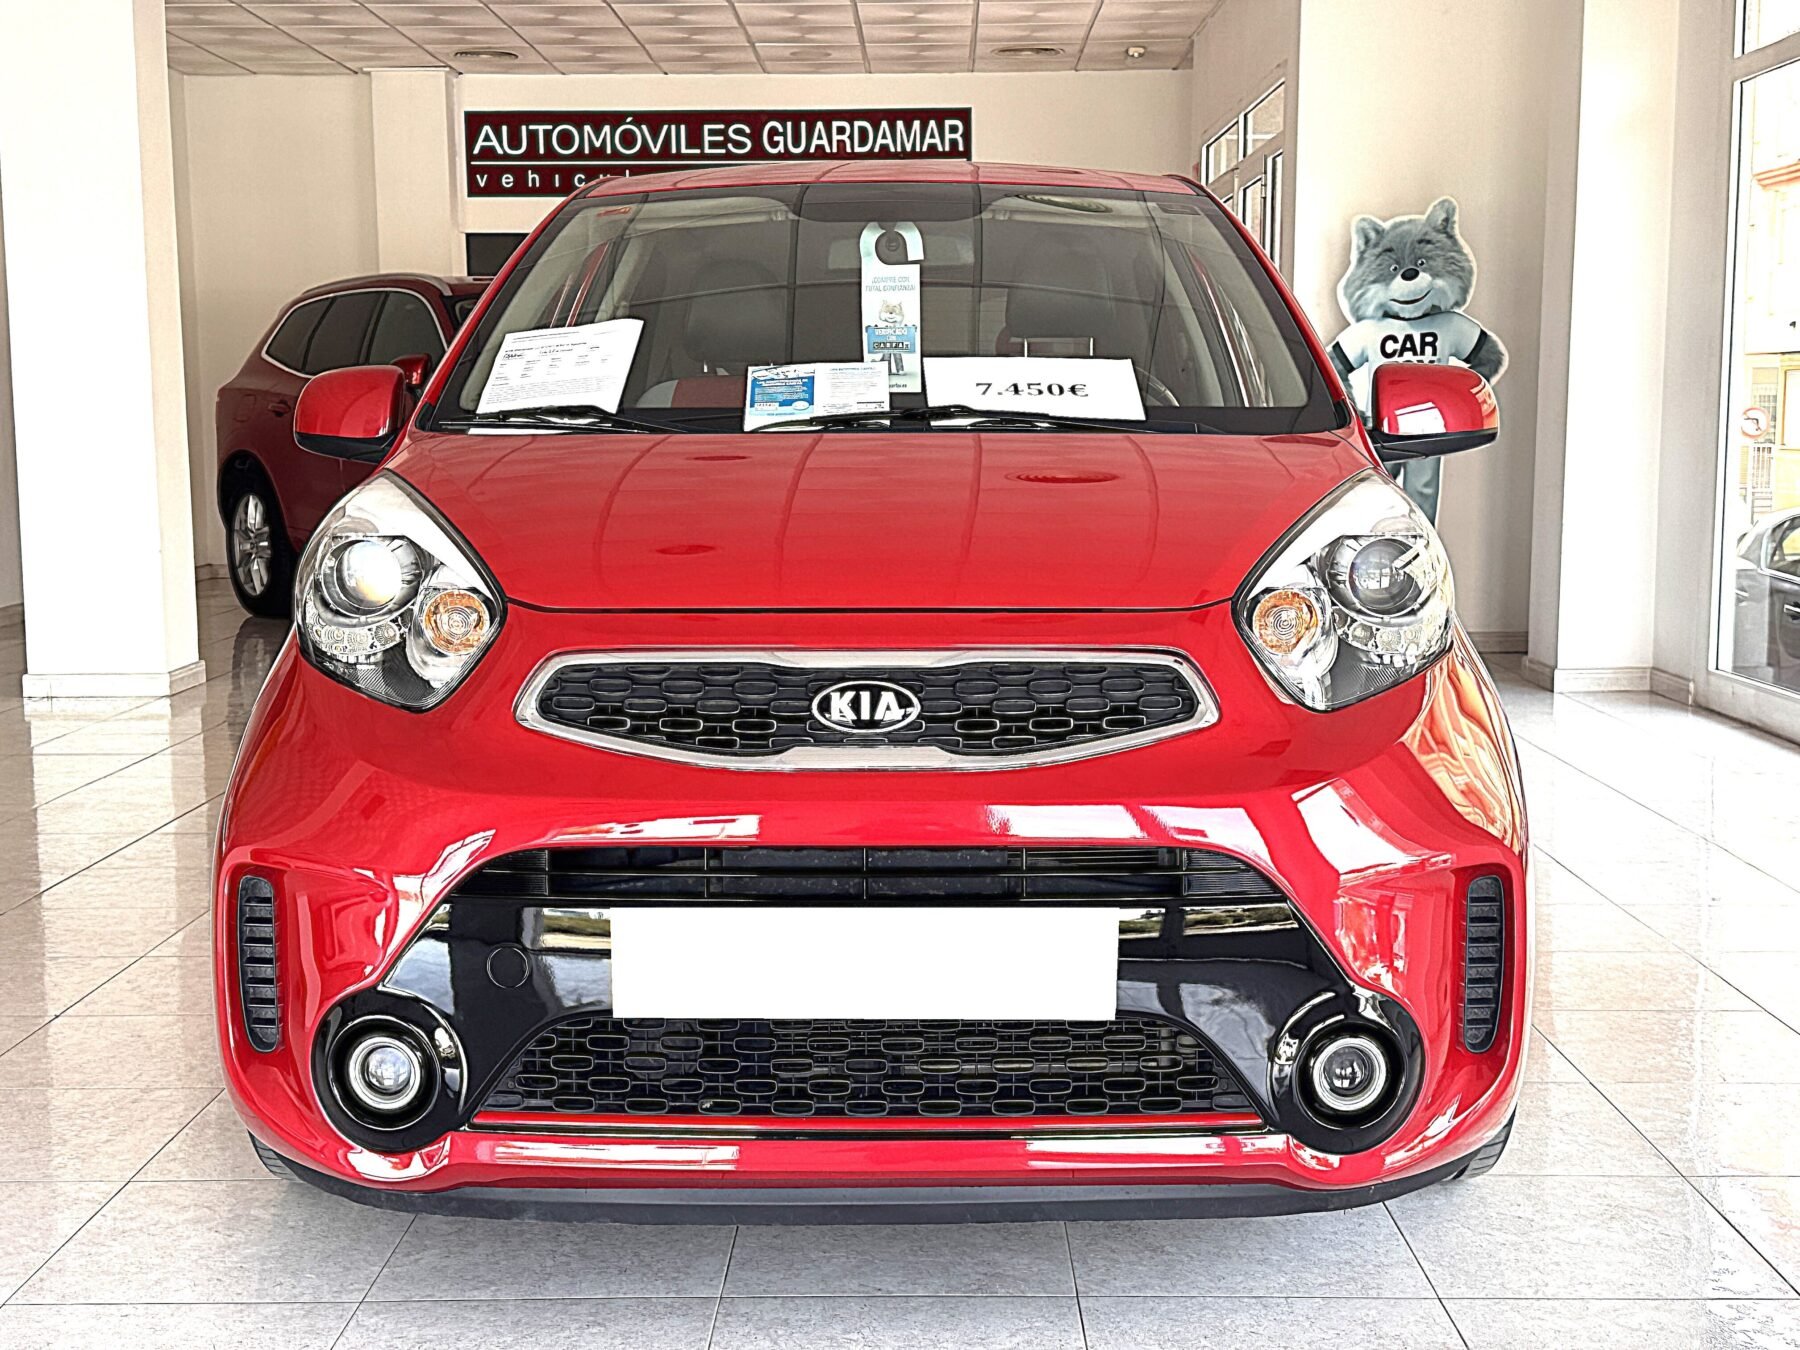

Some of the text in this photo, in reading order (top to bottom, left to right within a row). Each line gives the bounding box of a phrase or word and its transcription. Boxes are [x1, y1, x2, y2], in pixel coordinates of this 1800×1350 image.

[473, 117, 964, 154] AUTOMÓVILES GUARDAMAR
[1380, 332, 1439, 359] CAR
[975, 382, 1089, 397] 7.450€
[829, 691, 905, 721] KIA
